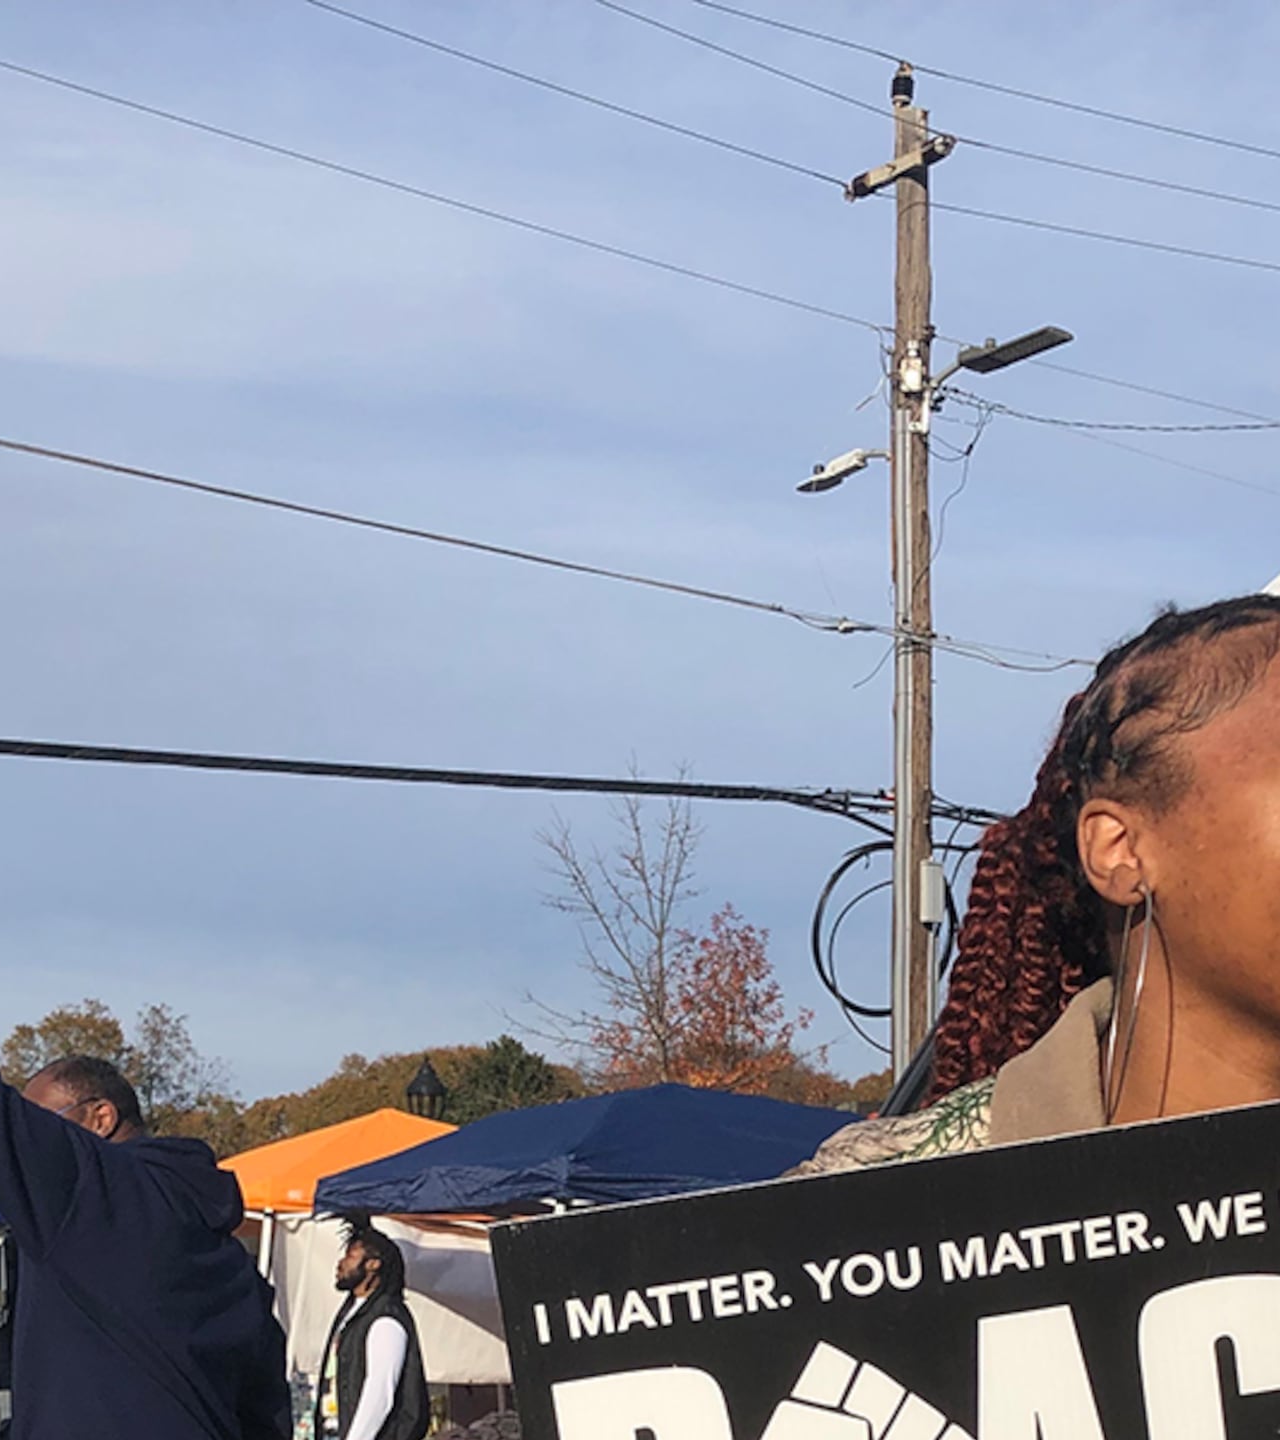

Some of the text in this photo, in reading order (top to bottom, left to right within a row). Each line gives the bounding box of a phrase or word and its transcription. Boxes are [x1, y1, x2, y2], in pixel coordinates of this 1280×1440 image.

[534, 1304, 551, 1344] I
[565, 1270, 793, 1340] MATTER.
[803, 1246, 922, 1301] YOU
[939, 1212, 1166, 1282] MATTER.
[1177, 1192, 1267, 1243] WE
